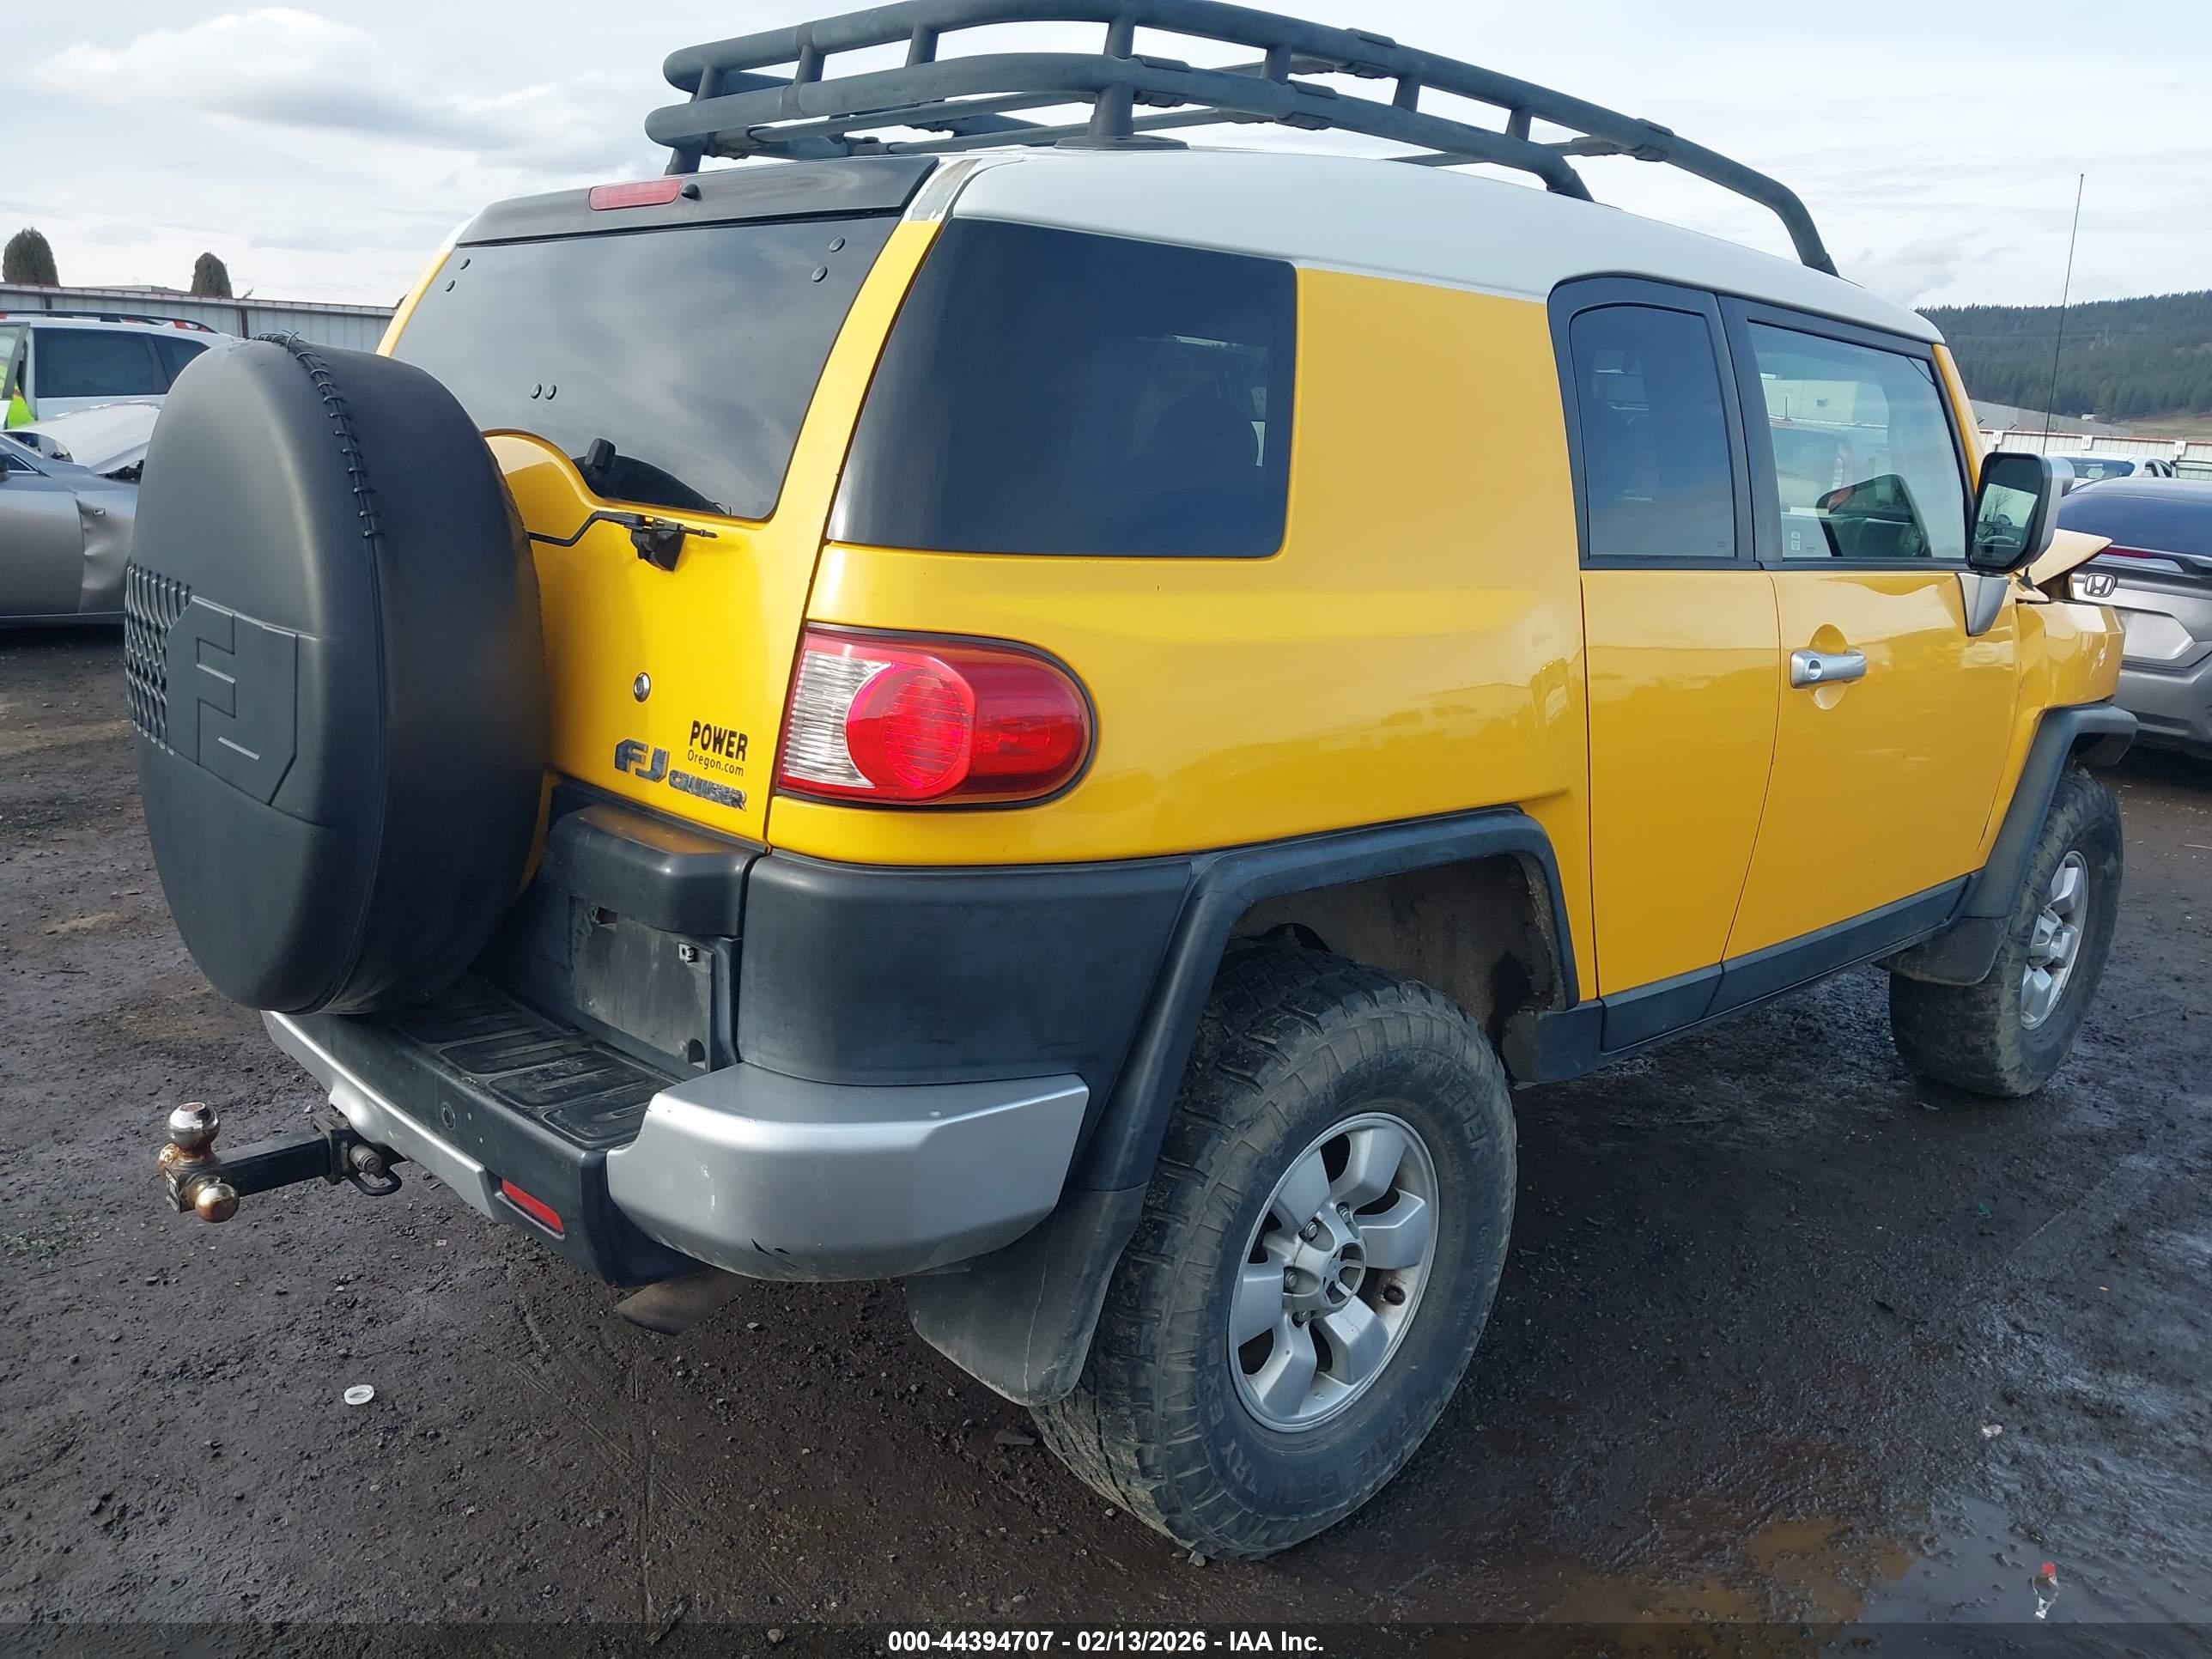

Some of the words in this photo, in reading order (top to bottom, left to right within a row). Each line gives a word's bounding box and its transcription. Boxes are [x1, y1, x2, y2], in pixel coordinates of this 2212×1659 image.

[690, 720, 748, 762] POWER
[614, 738, 670, 783] FJ
[669, 769, 747, 811] CRUISER
[688, 750, 744, 776] Oregon.com
